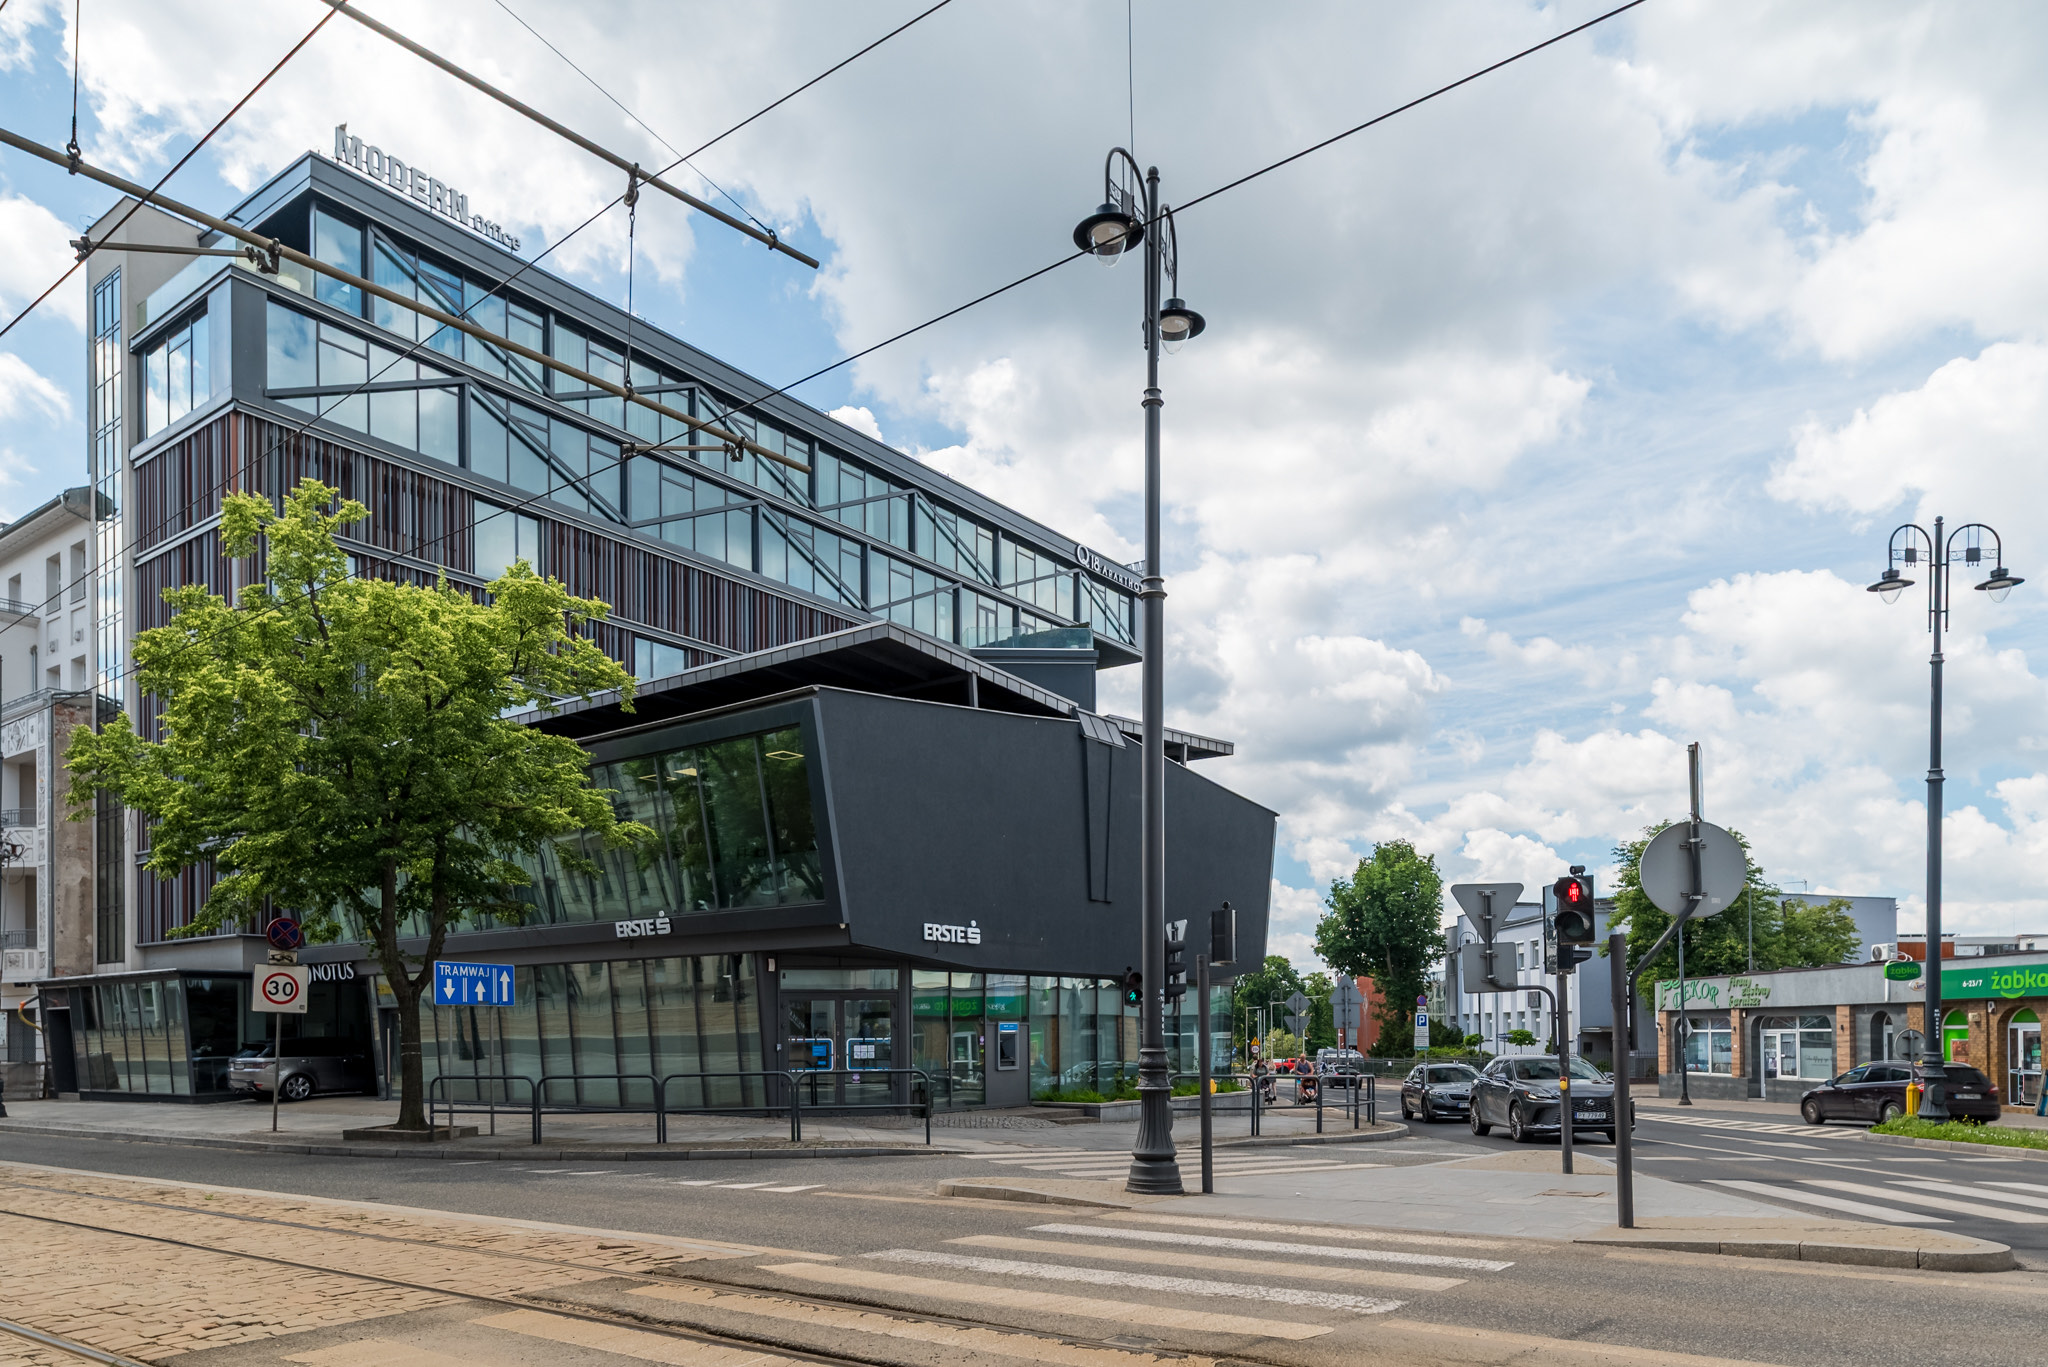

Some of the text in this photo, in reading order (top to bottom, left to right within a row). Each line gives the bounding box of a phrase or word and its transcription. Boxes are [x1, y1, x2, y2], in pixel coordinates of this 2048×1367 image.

[334, 126, 469, 226] MODERN
[615, 918, 656, 938] ERSTE
[923, 922, 967, 944] ERSTE
[312, 962, 355, 982] NOTUS
[439, 964, 490, 978] TRAMWAJ
[267, 980, 294, 997] 30
[1418, 1015, 1426, 1026] P
